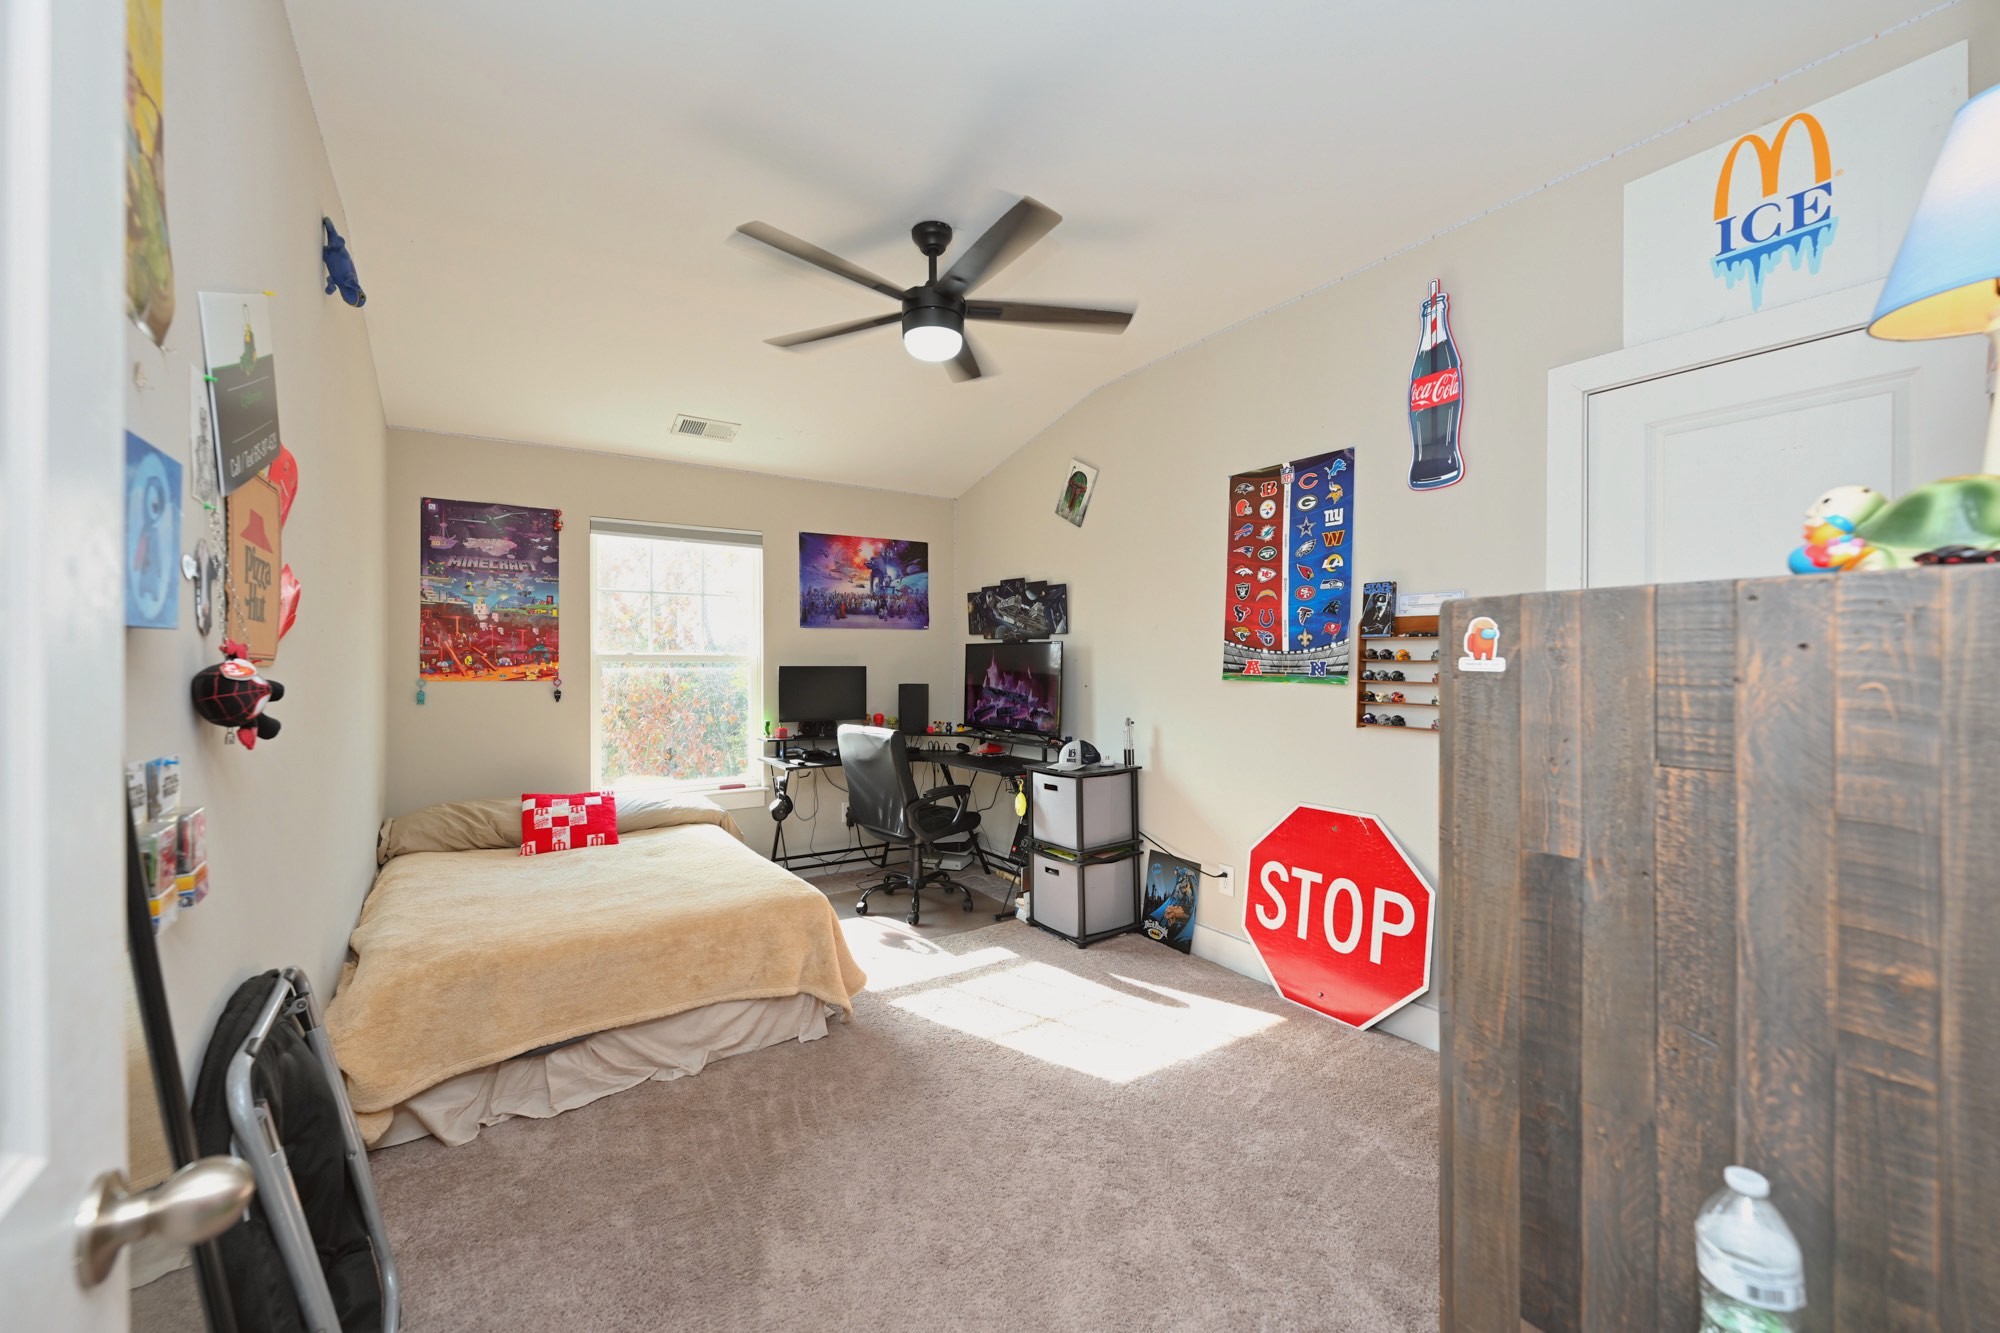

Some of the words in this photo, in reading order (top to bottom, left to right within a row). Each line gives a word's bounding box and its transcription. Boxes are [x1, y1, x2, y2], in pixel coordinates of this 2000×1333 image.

[1715, 181, 1832, 257] ICE
[1282, 473, 1293, 482] NFL
[1297, 495, 1317, 511] G
[1322, 529, 1345, 547] W
[244, 544, 271, 591] Pizza
[447, 556, 538, 572] MINECRAFT
[245, 583, 266, 623] Hut
[1243, 659, 1262, 675] A
[1309, 660, 1327, 677] N
[1255, 860, 1416, 966] STOP
